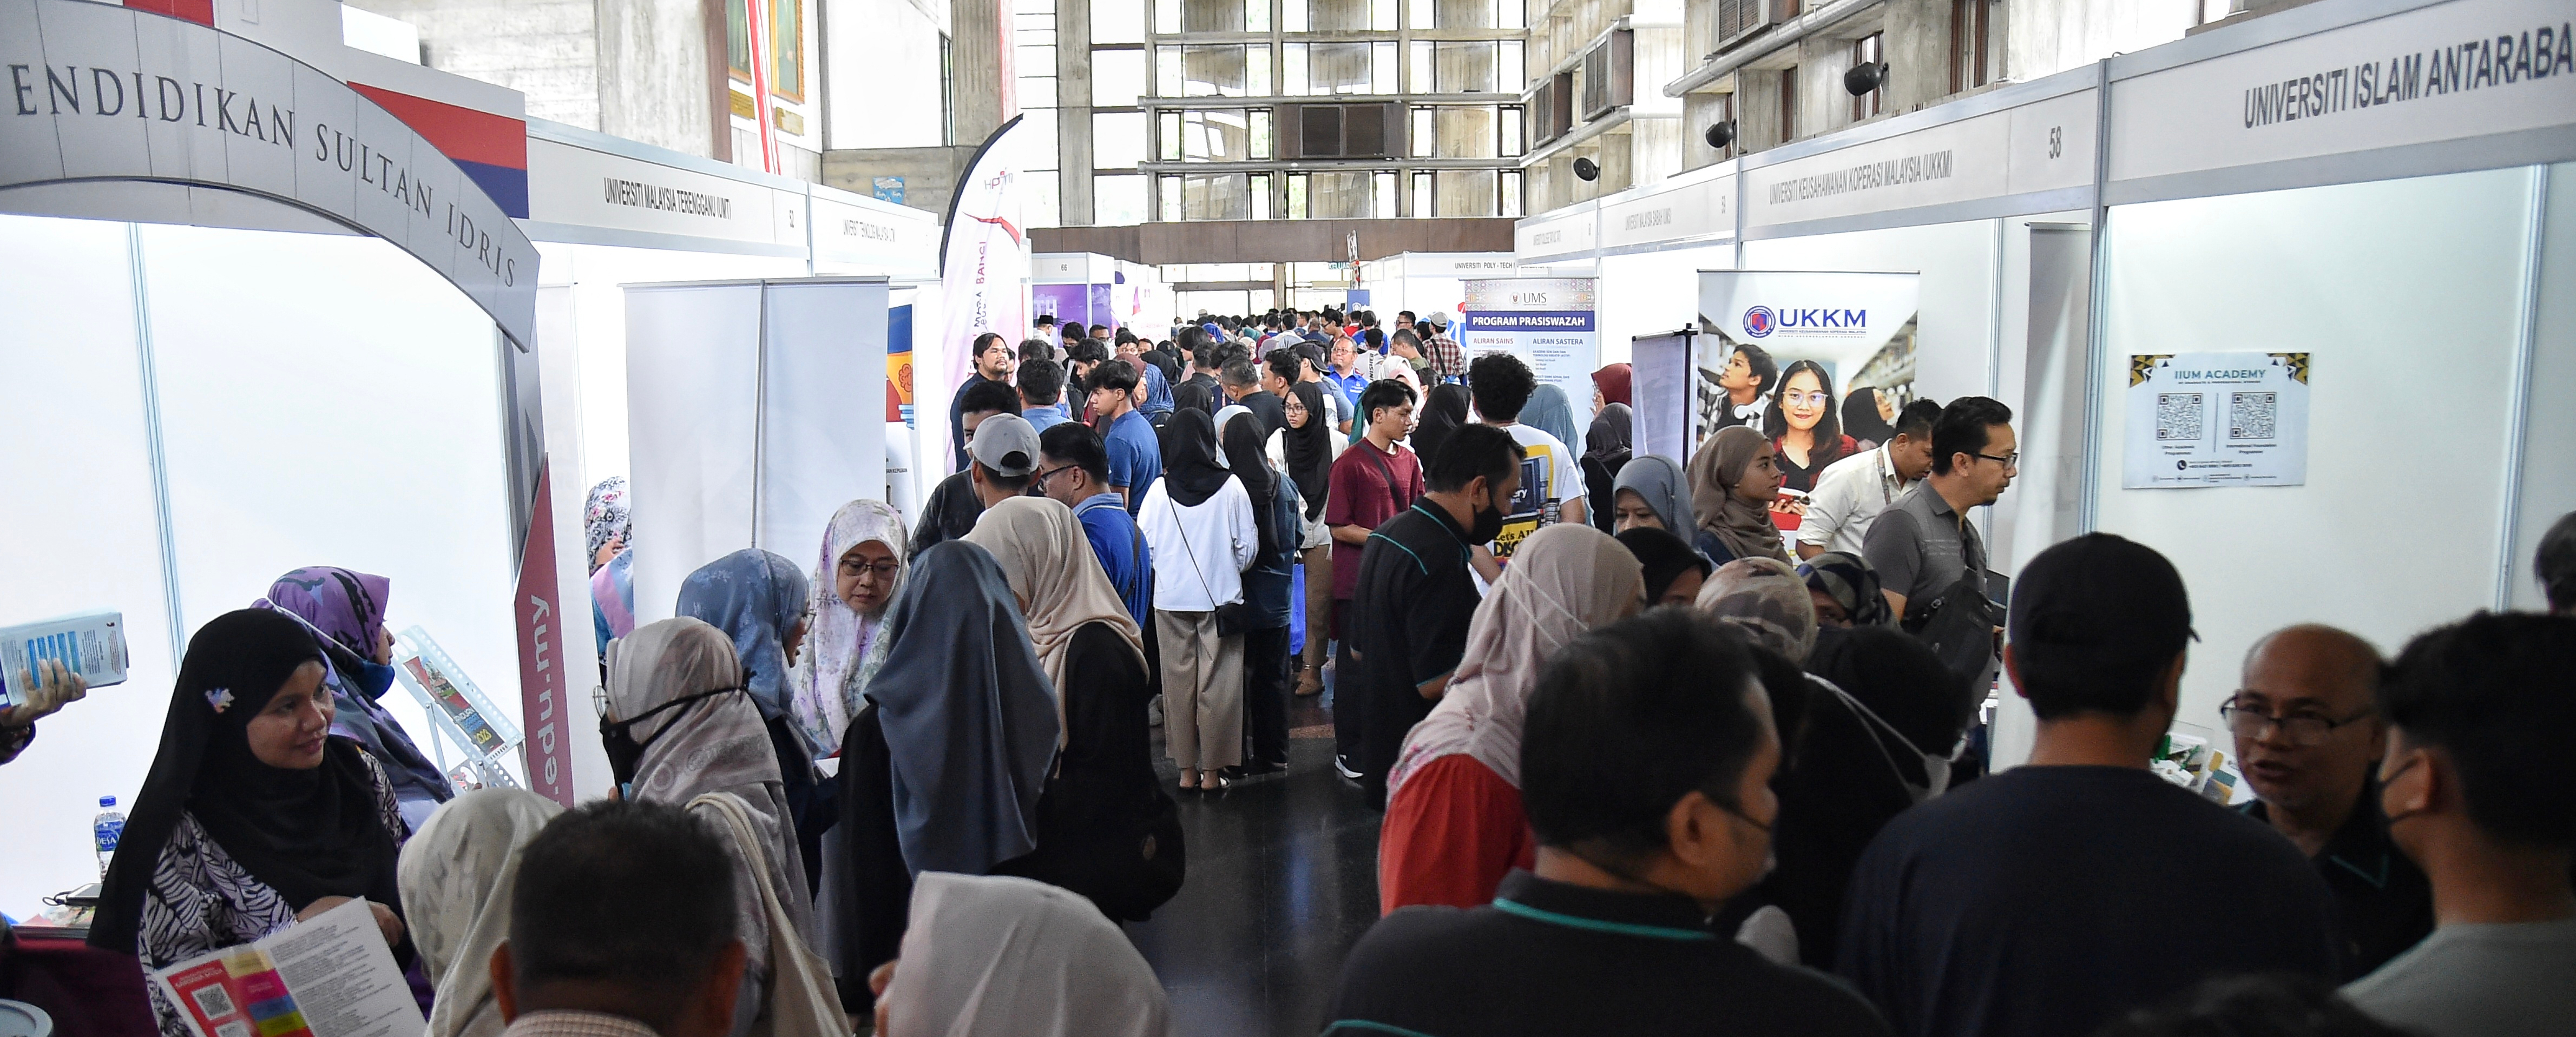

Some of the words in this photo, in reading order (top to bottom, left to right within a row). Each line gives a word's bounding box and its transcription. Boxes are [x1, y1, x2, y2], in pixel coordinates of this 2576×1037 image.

[2244, 68, 2348, 129] UNIVERSITI
[2353, 52, 2422, 109] ISLAM
[2049, 126, 2061, 159] 58
[7, 63, 295, 150] ENDIDIKAN
[317, 123, 433, 219] SULTAN
[448, 202, 516, 288] IDRIS
[1769, 180, 1797, 205] UNIVERSITI
[1798, 169, 1848, 201] KEUSAHAWANAN
[1849, 162, 1884, 192] KOPERASI
[1884, 155, 1921, 186] MALAYSIA
[1923, 149, 1953, 180] (UKKM)
[603, 177, 643, 208] UNIVERSITI
[644, 184, 676, 212] MALAYSIA
[676, 190, 716, 217] TERENGGANU
[1523, 293, 1547, 303] UMS
[1473, 316, 1517, 326] PROGRAM
[1519, 316, 1585, 326] PRASISWAZAH
[1779, 309, 1867, 327] UKKM
[2174, 370, 2201, 379] IIUM
[2205, 369, 2266, 379] ACADEMY
[531, 595, 561, 807] .edu.my
